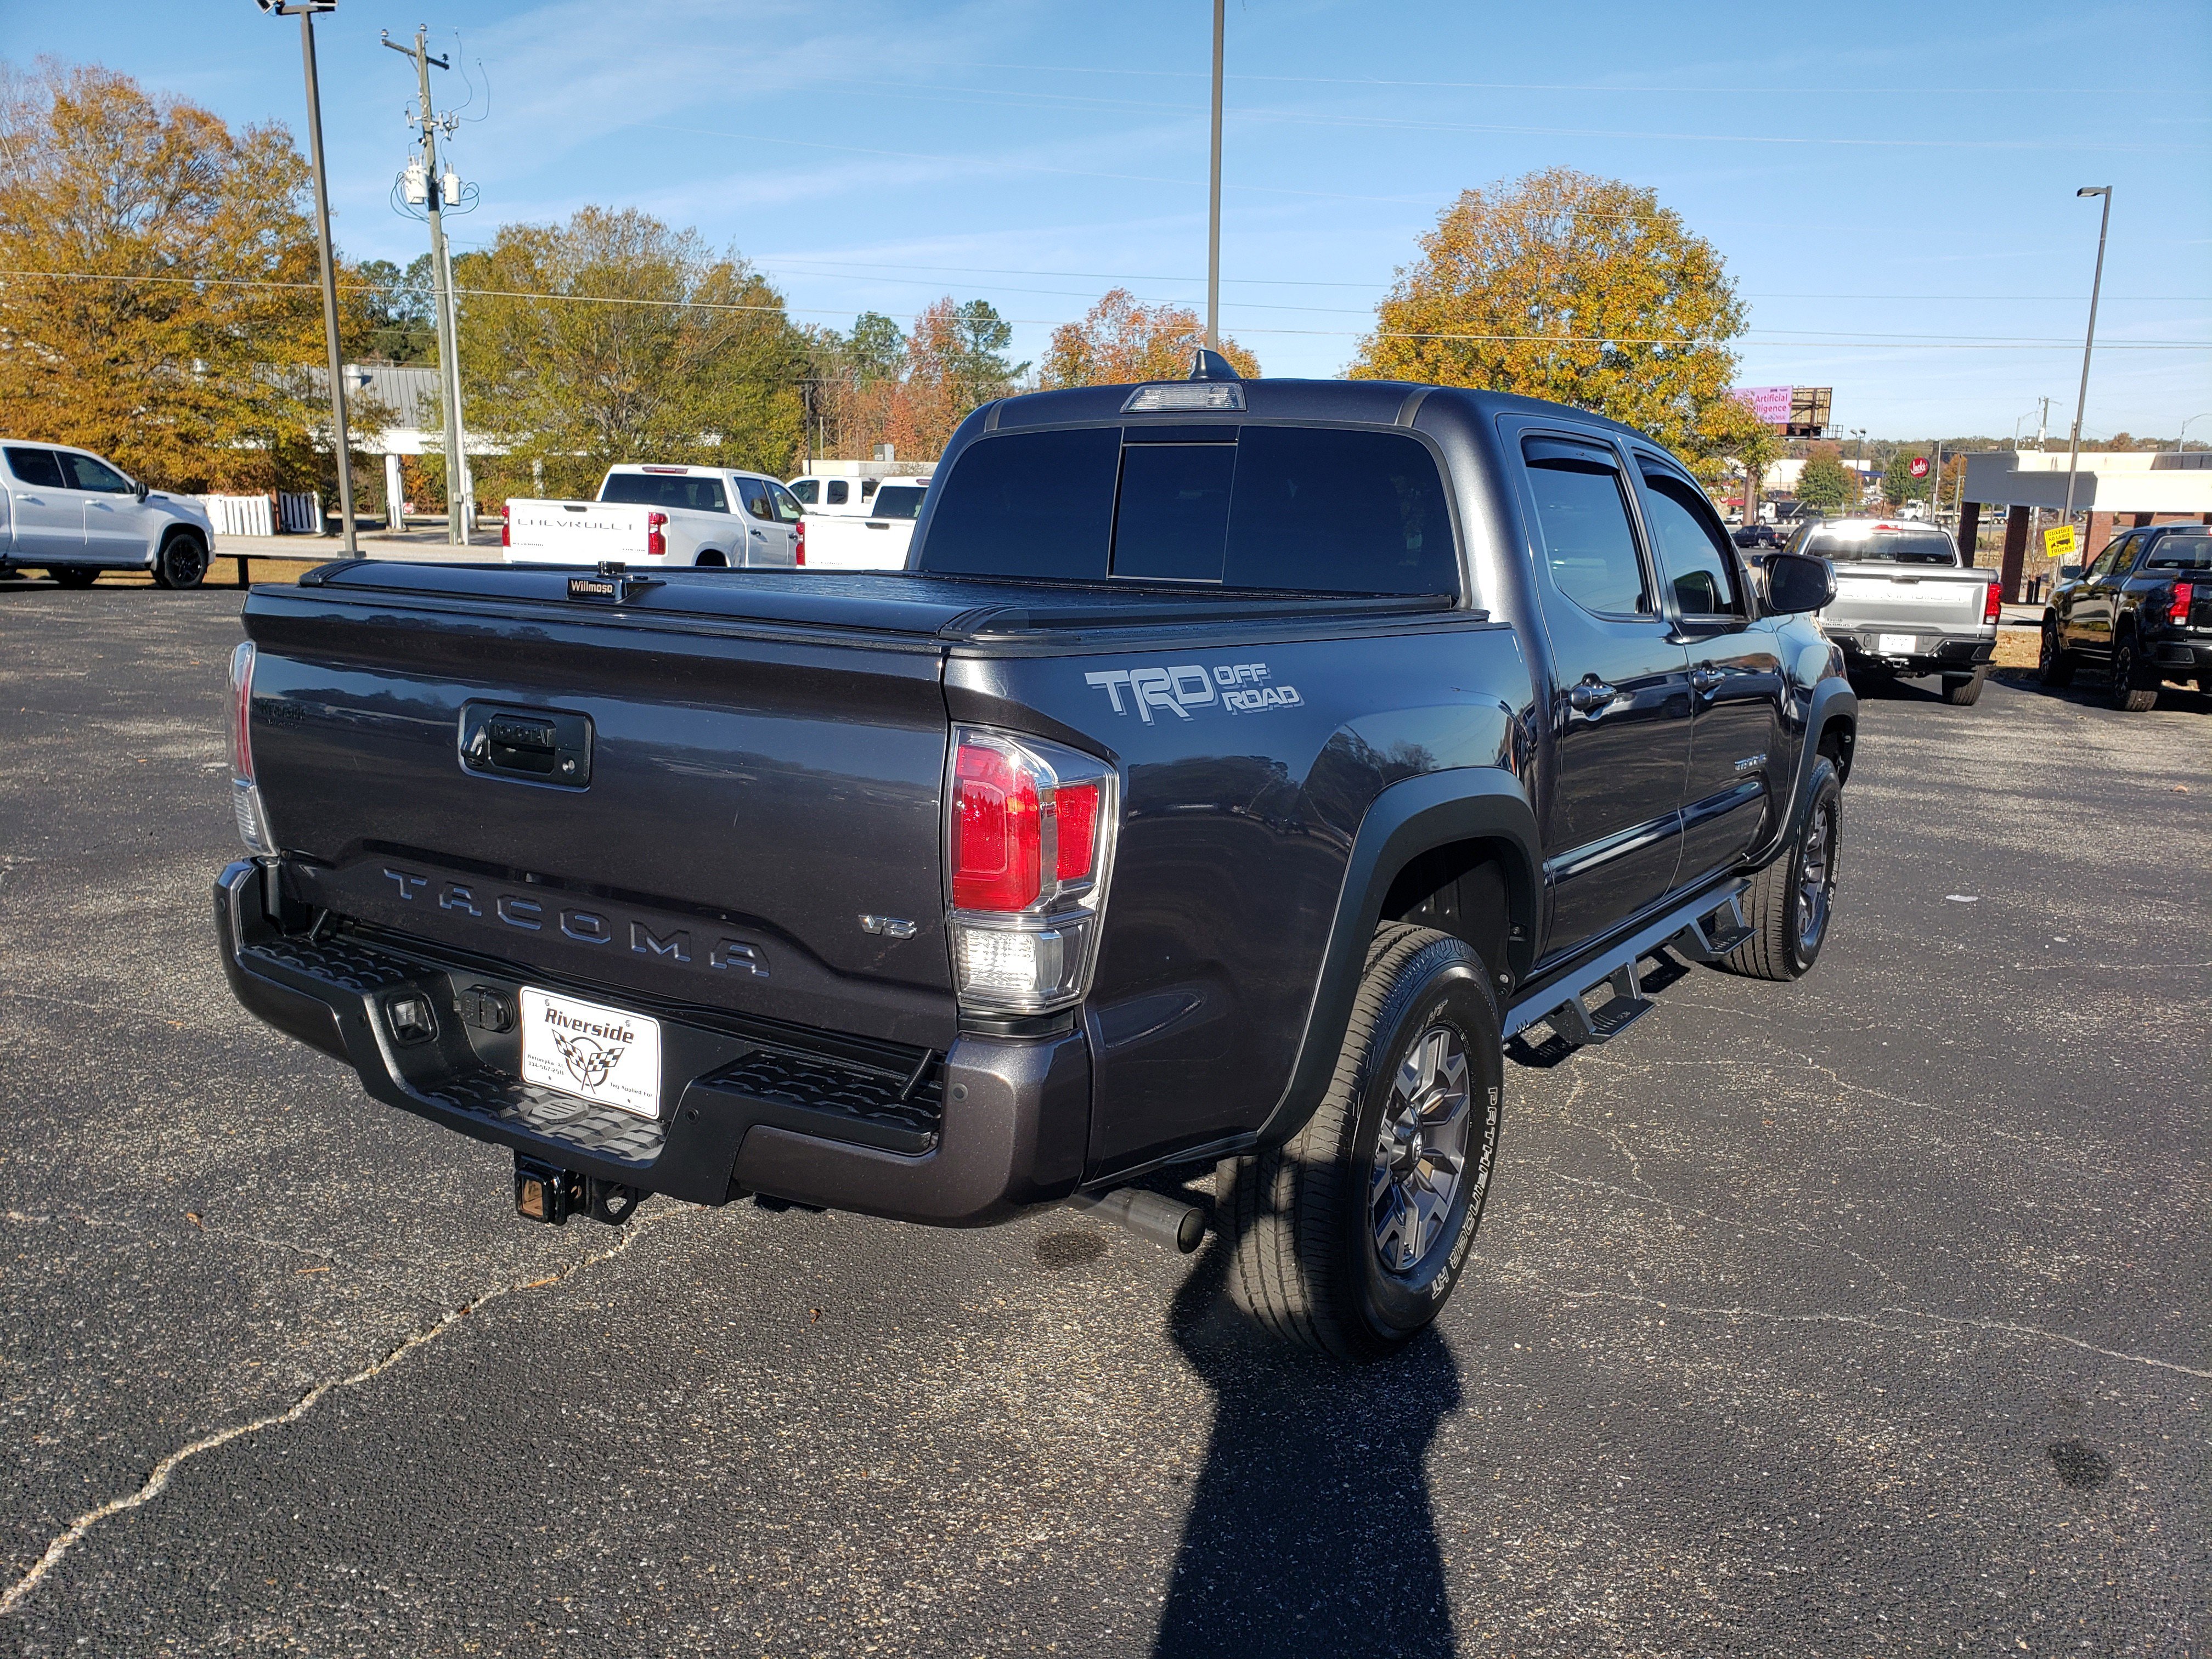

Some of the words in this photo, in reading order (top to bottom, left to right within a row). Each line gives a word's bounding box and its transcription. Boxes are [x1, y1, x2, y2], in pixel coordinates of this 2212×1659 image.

[1756, 393, 1787, 402] Artificial
[571, 580, 613, 594] Willmoso
[1213, 663, 1272, 690] OFF
[1084, 664, 1219, 727] TRD
[1221, 686, 1305, 716] ROAD
[383, 868, 769, 977] TACOMA
[857, 913, 917, 940] V6
[545, 1007, 634, 1045] Riverside
[621, 1085, 642, 1095] Applied
[1449, 1086, 1498, 1270] PATHFINDER
[1431, 1266, 1450, 1300] HT
